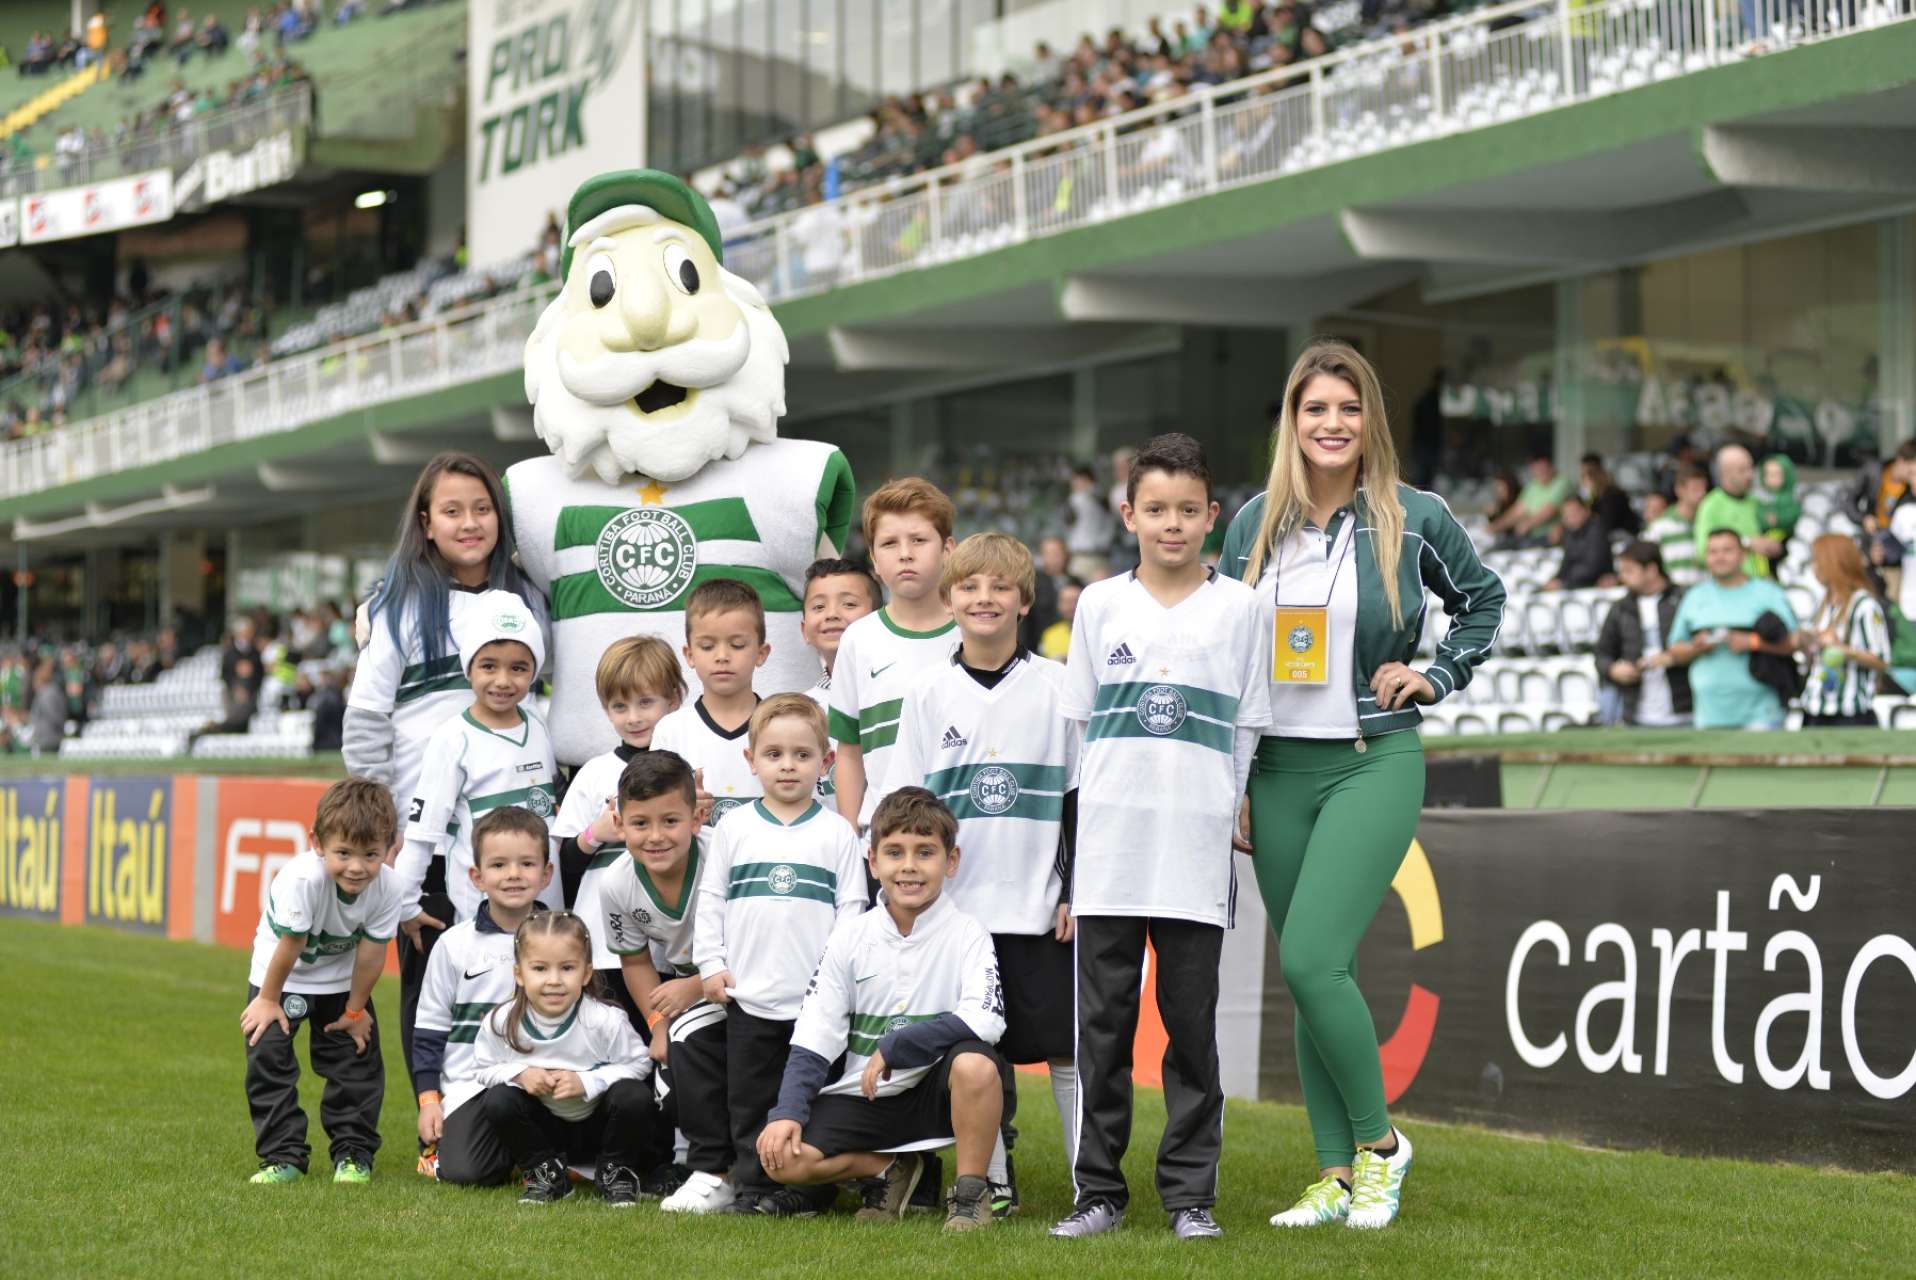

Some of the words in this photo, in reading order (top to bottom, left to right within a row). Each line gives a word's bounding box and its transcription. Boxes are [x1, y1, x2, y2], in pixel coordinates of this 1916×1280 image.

[484, 13, 569, 104] PRO
[480, 79, 589, 183] TORK
[599, 524, 622, 585] CORITIBA
[622, 511, 660, 525] FOOT
[660, 513, 688, 542] BALL
[678, 544, 693, 580] CLUB
[615, 542, 675, 568] CFC
[1107, 654, 1136, 666] adidas
[1148, 703, 1175, 717] CFC
[941, 738, 968, 750] adidas
[981, 784, 1007, 797] CFC
[89, 788, 166, 924] Itaú
[1506, 873, 1916, 1100] cartão
